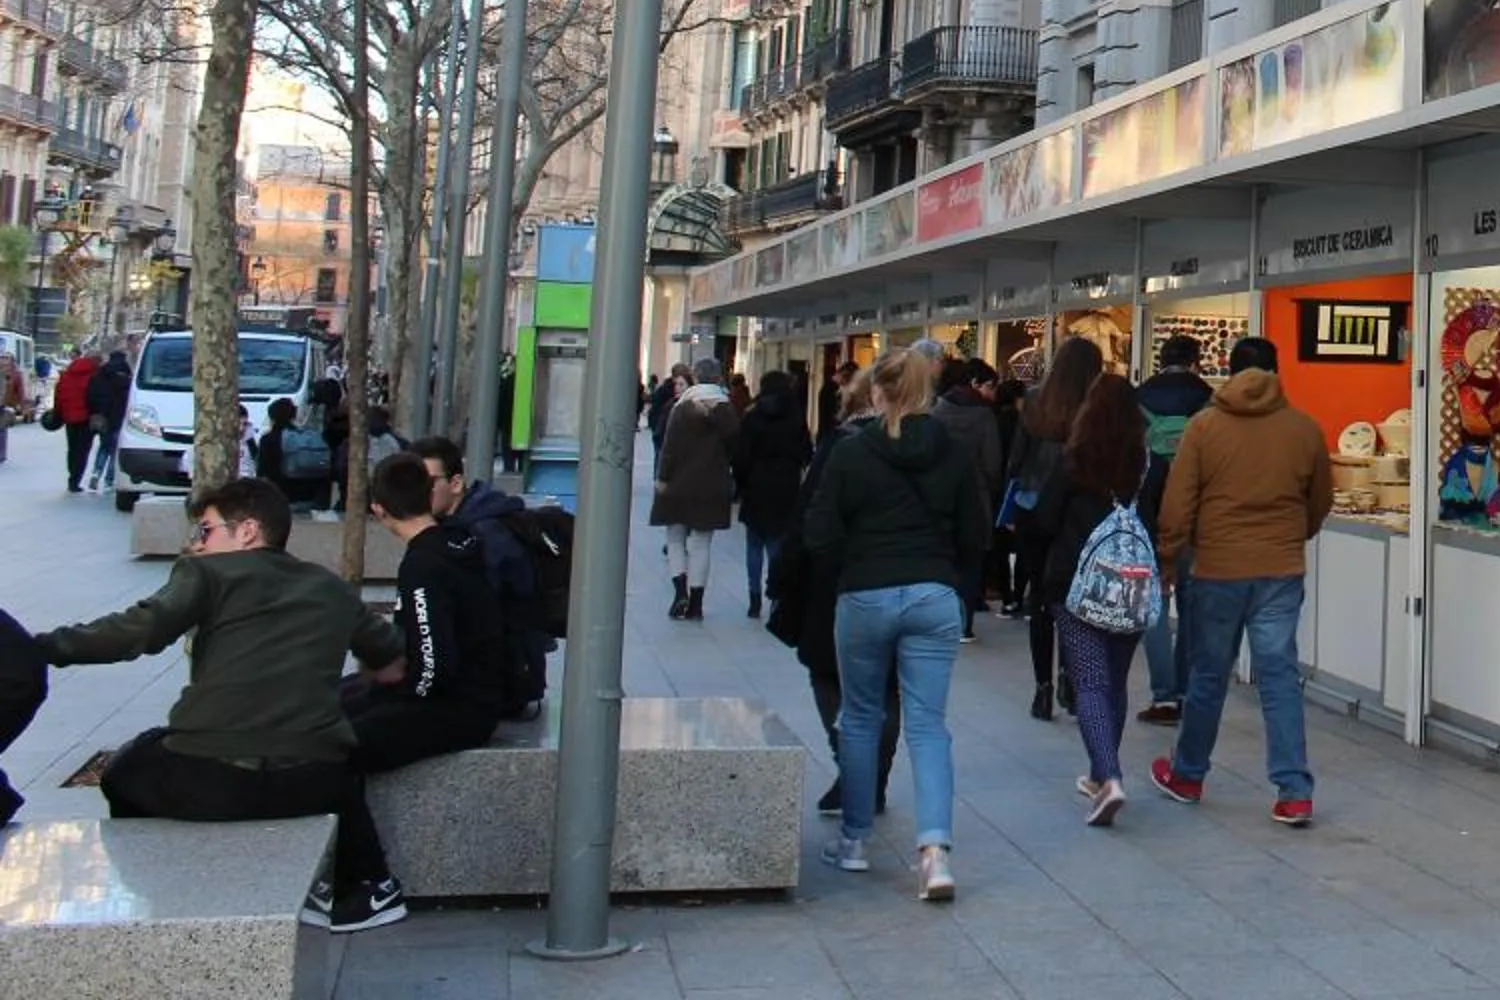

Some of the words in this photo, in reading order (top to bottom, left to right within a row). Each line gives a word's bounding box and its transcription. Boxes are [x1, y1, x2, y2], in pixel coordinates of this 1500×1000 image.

[1474, 209, 1497, 235] LES
[1327, 232, 1340, 253] DE
[1425, 233, 1439, 257] 10
[413, 587, 431, 635] WORLD
